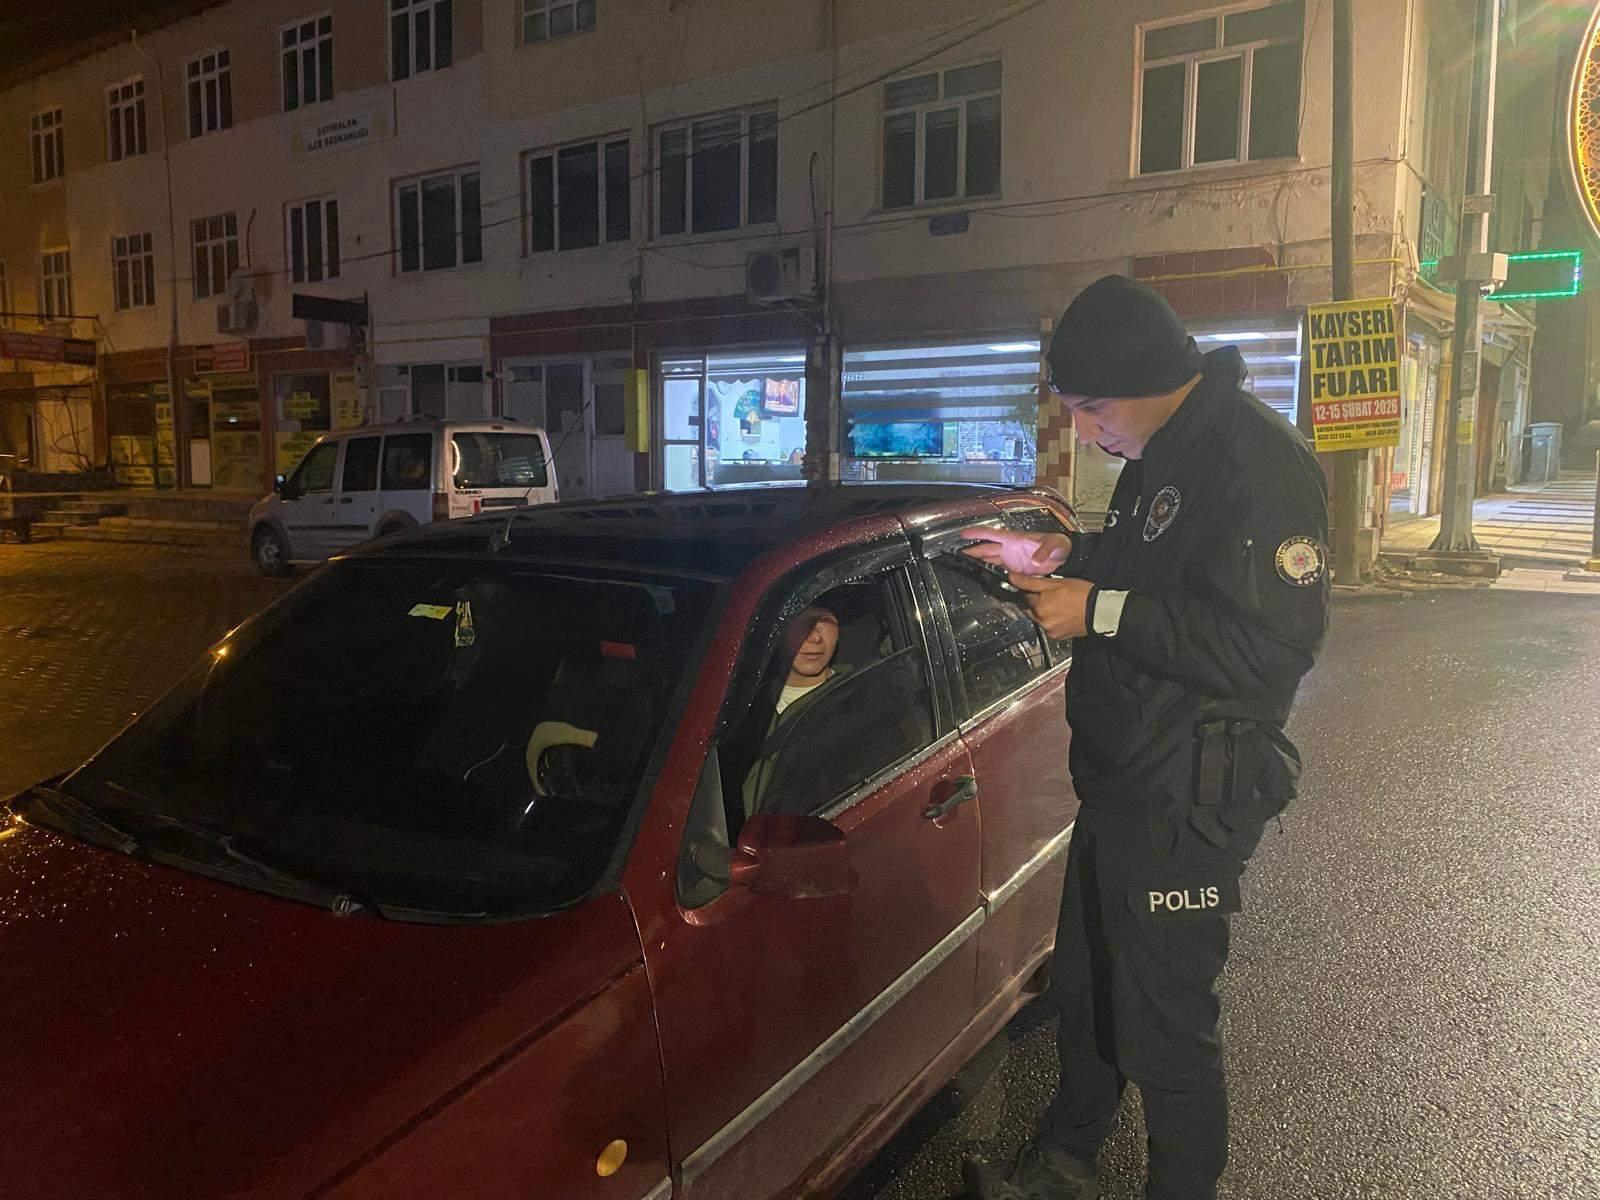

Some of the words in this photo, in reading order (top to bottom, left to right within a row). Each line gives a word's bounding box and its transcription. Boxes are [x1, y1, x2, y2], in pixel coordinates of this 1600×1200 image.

[1311, 304, 1393, 339] KAYSERİ
[1312, 337, 1396, 368] TARIM
[1313, 367, 1398, 398] FUARI
[1315, 404, 1341, 420] 12-15
[1342, 401, 1372, 421] ŞUBAT
[1374, 398, 1398, 415] 2026
